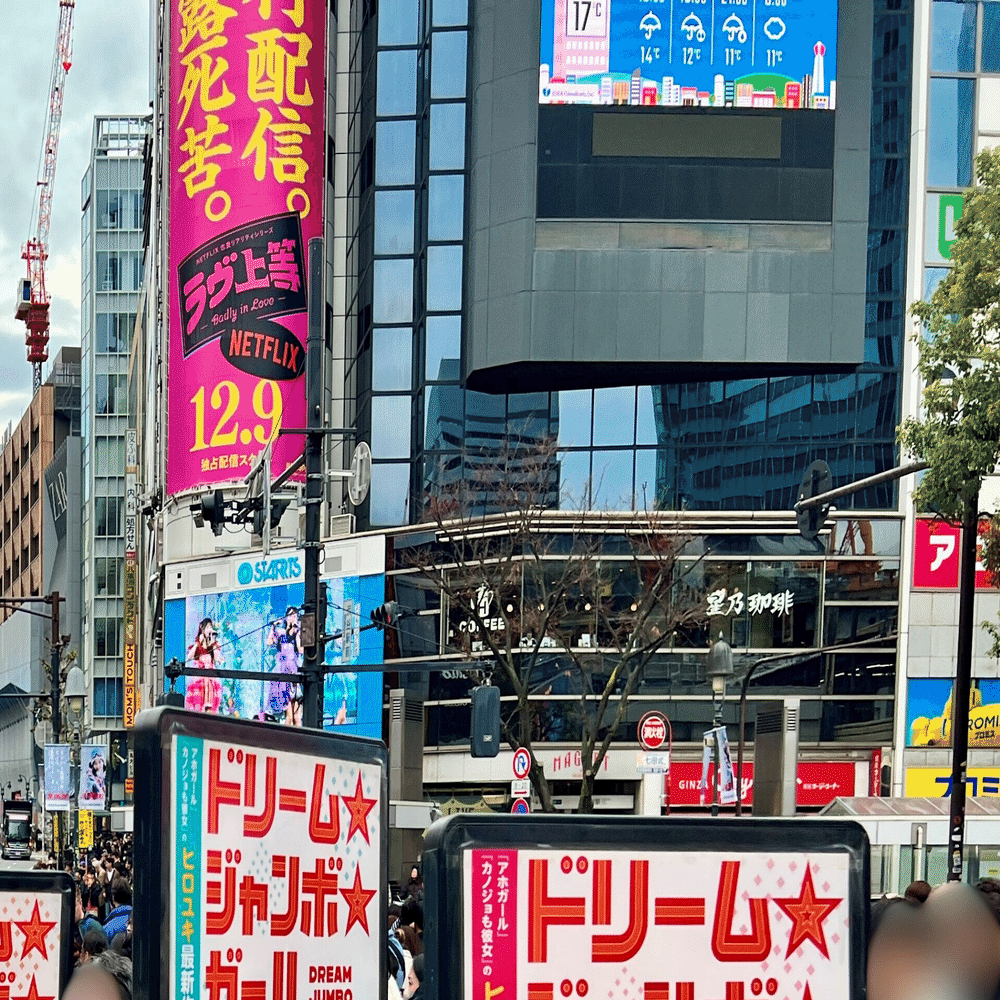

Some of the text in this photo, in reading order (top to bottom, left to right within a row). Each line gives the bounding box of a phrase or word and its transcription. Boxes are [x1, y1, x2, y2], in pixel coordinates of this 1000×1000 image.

[183, 238, 302, 336] ラヴ上等
[211, 297, 275, 326] Badly in Love
[229, 329, 300, 373] NETFLIX
[189, 379, 283, 452] 12.9
[126, 518, 136, 550] 処方せん
[706, 587, 795, 618] 星乃珈琲
[459, 617, 506, 633] COFEE
[126, 643, 134, 726] MOM'S TOUCH
[553, 750, 609, 772] MAGT
[206, 747, 341, 845] ドリーム
[205, 848, 343, 938] ジャンボ
[527, 855, 772, 963] ドリーム
[308, 965, 353, 984] DREAM
